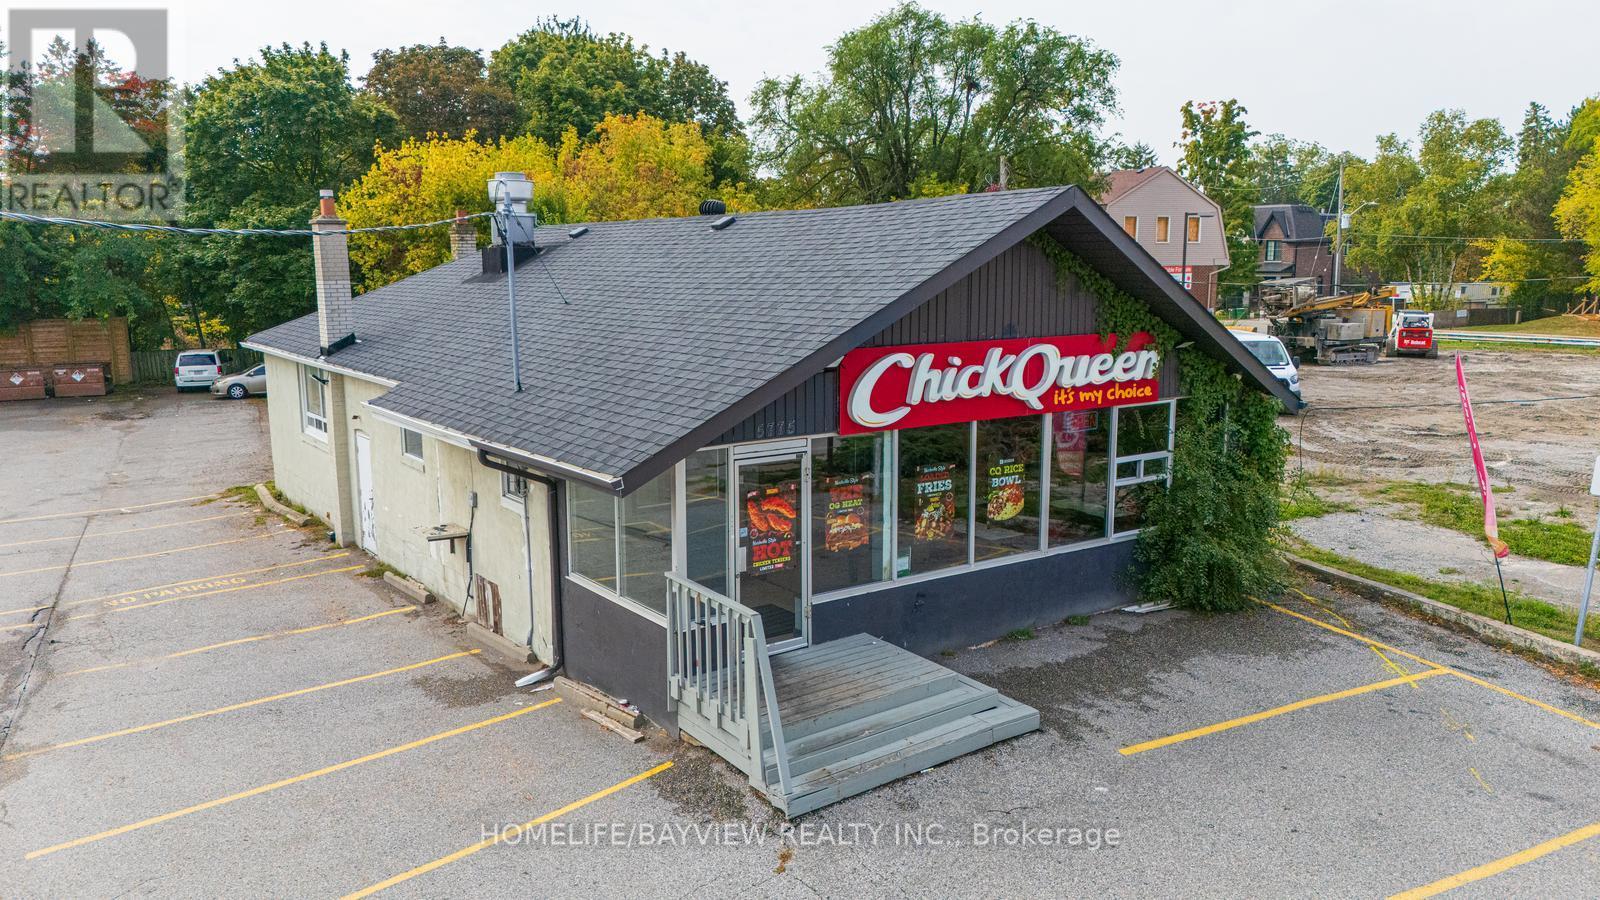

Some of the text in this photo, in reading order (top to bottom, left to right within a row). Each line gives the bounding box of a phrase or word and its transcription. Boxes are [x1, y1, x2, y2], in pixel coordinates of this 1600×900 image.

[847, 344, 1159, 427] ChickQueen
[1054, 383, 1153, 405] it's my choice
[1004, 464, 1024, 473] RICE
[917, 479, 952, 494] FRIES
[991, 475, 1022, 487] BOWL
[842, 499, 863, 508] HEAT
[752, 540, 792, 561] HOT
[753, 559, 771, 567] CHICKEN
[144, 577, 247, 600] PARKING
